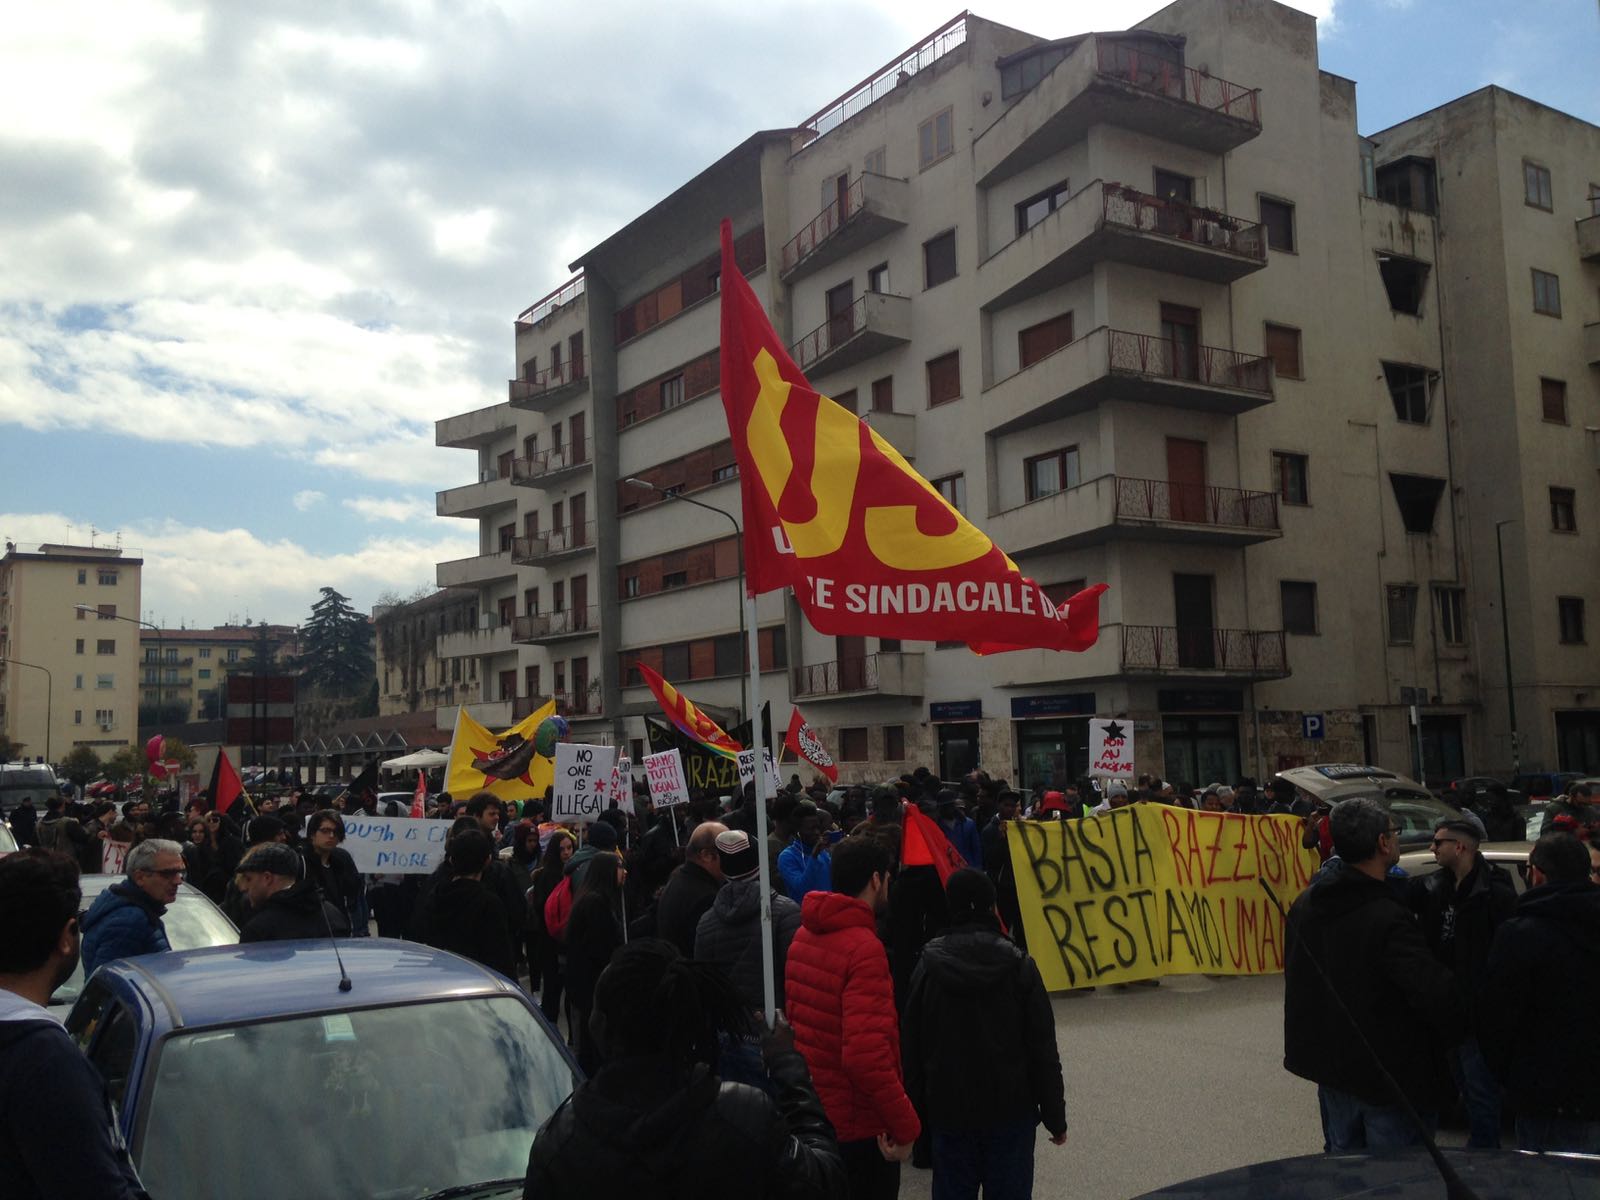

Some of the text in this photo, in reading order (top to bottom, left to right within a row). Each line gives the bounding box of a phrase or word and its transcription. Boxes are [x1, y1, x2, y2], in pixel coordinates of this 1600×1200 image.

[845, 579, 1036, 615] SINDACALE
[1306, 717, 1321, 737] P
[1103, 736, 1125, 747] NON
[576, 750, 593, 763] NO
[645, 754, 676, 770] SIAMO
[1101, 749, 1120, 760] AU
[568, 765, 593, 777] ONE
[648, 765, 678, 780] TUTTI
[574, 779, 586, 791] IS
[377, 852, 428, 867] MORE
[1016, 806, 1157, 898] BASTA
[1043, 889, 1222, 987] RESTIAMO
